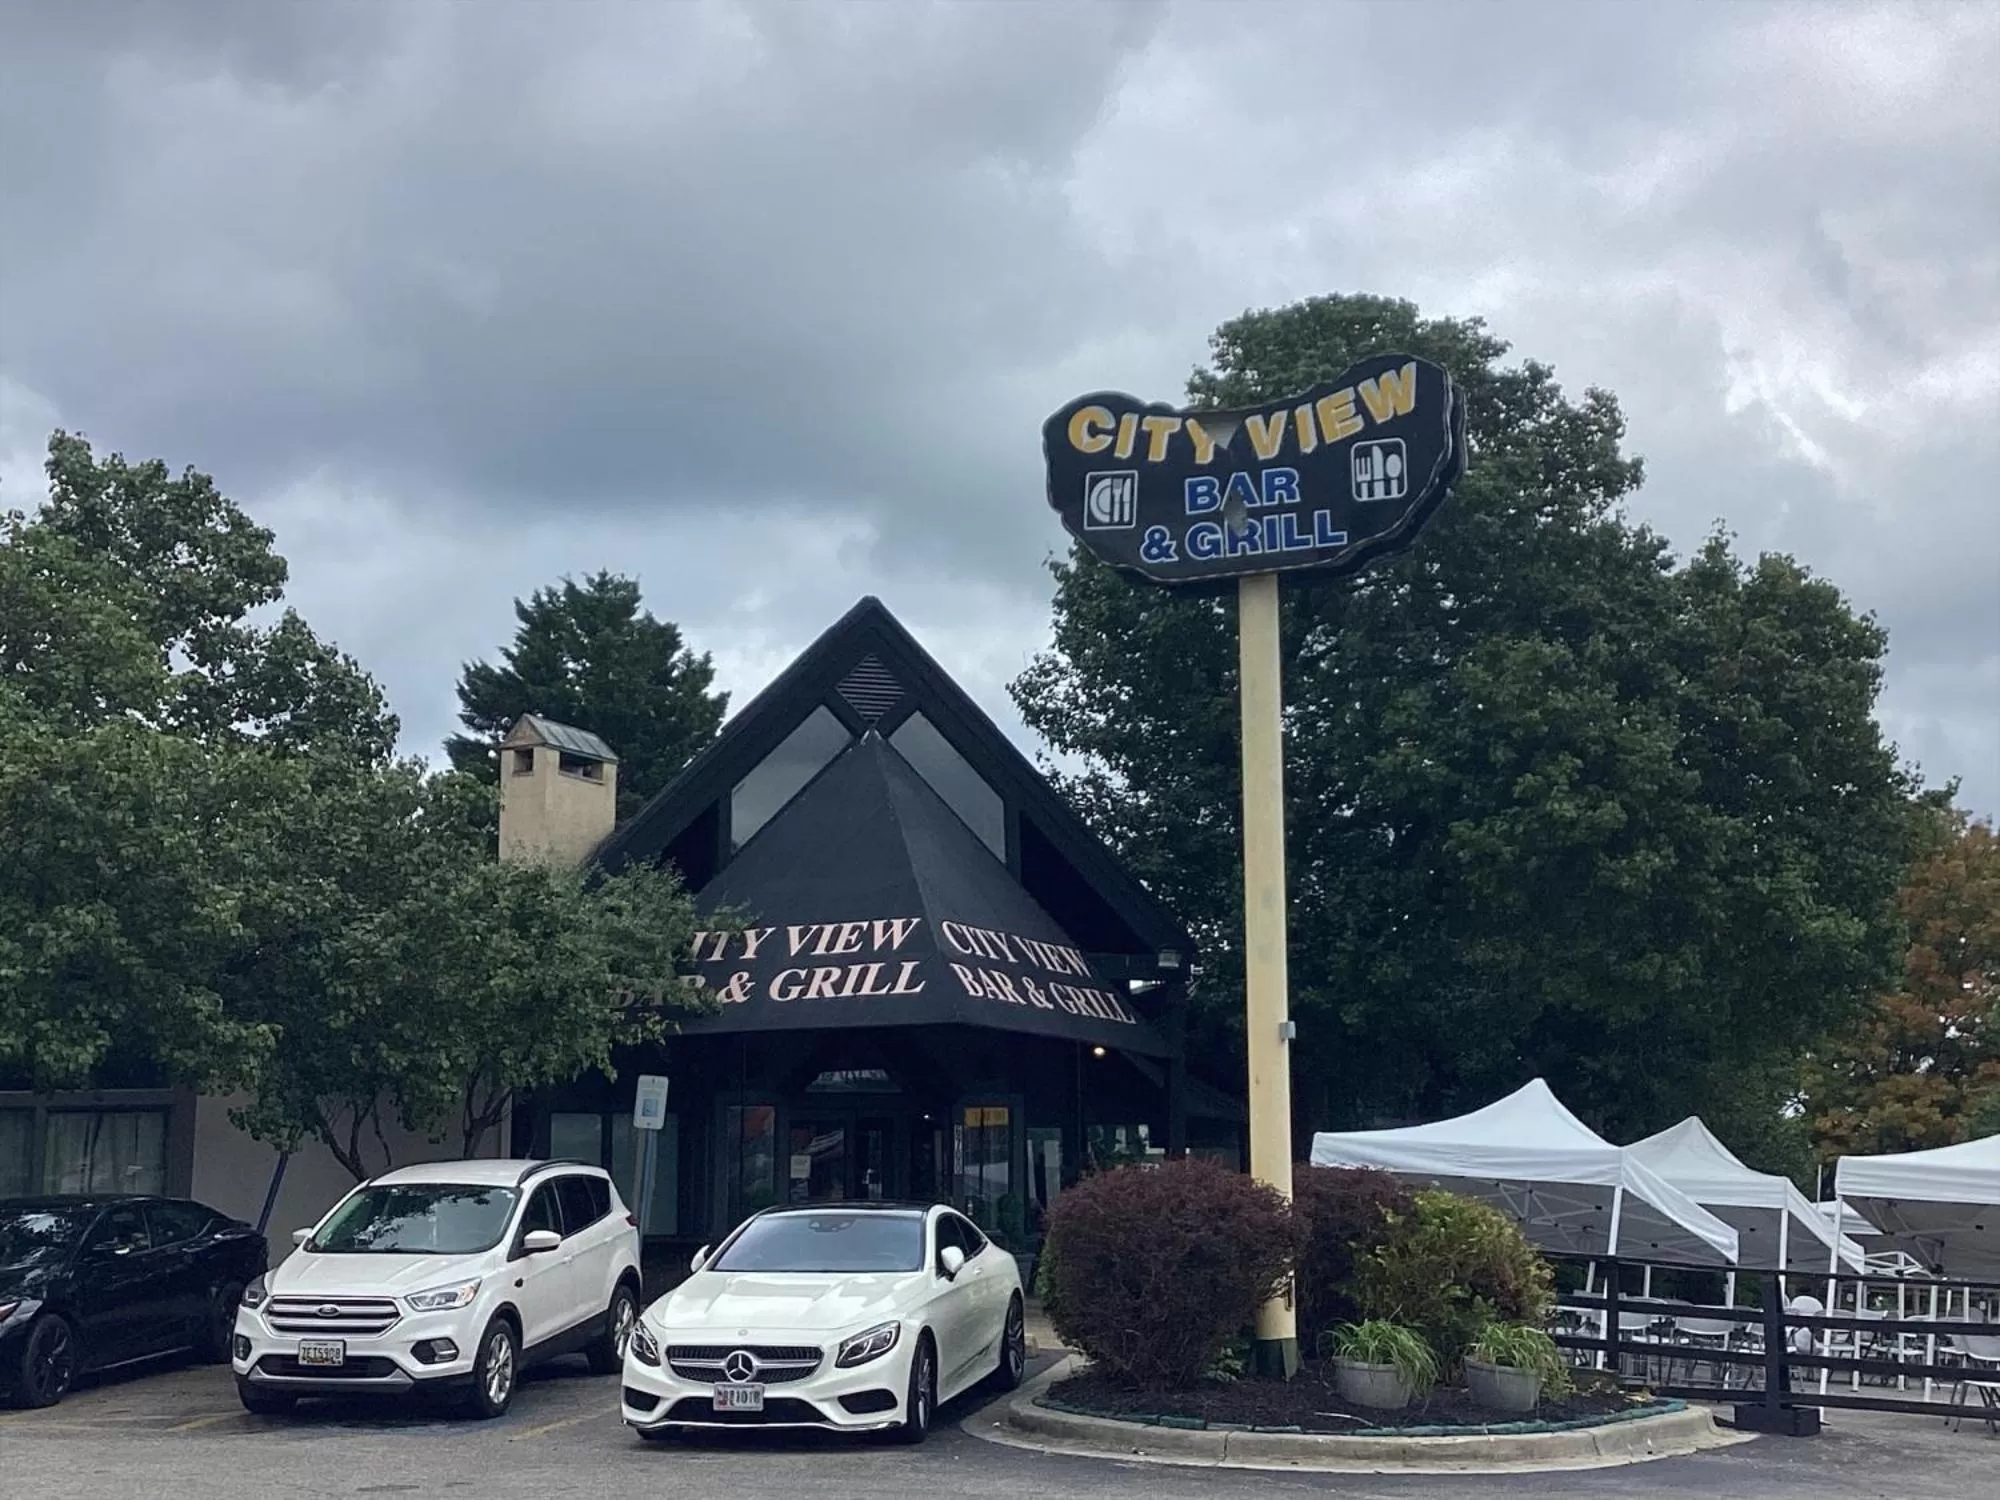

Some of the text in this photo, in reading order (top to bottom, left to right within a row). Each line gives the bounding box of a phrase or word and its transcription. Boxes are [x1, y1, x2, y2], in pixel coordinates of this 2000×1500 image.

[1067, 361, 1417, 465] CITY VIEW
[1185, 467, 1300, 515] BAR
[1140, 510, 1348, 564] & GRILL
[689, 917, 921, 961] ITY VIEW
[941, 920, 1094, 978] CITY VIEW
[716, 970, 755, 1003] &
[769, 961, 926, 1001] GRILL
[950, 962, 1137, 1024] BAR & GRILL
